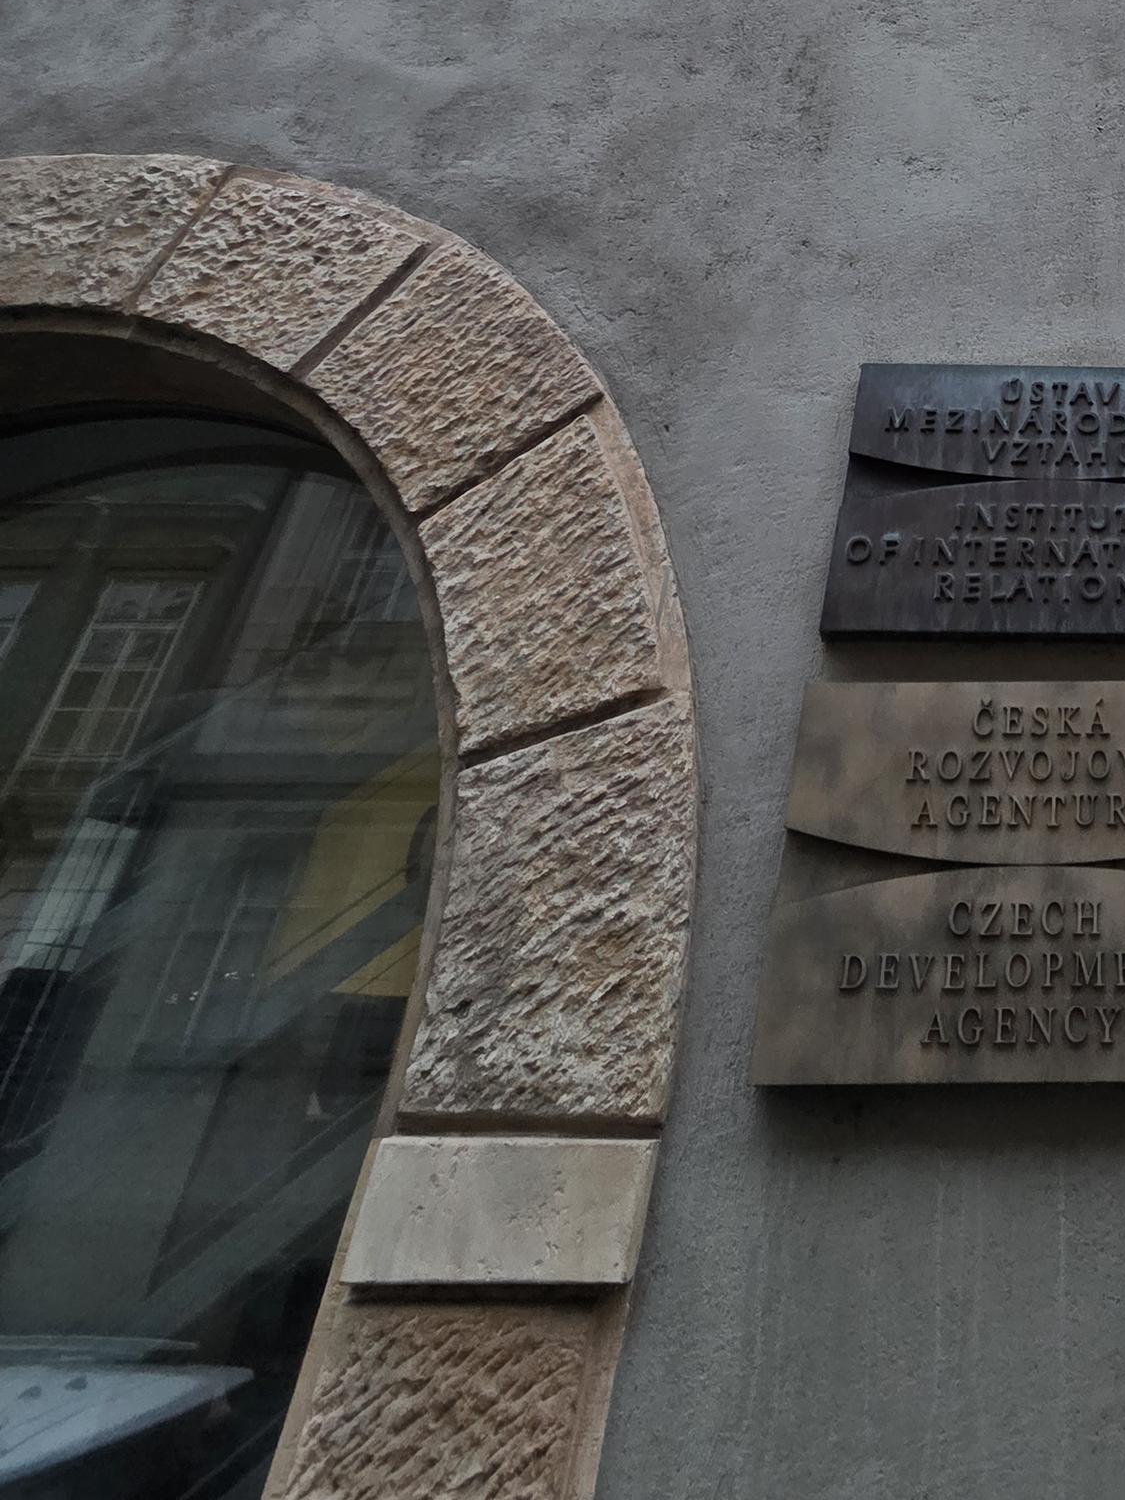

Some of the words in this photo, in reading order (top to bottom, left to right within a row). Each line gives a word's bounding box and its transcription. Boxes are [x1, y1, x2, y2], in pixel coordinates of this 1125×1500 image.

[845, 533, 900, 566] OF
[971, 697, 1111, 739] ČESKÁ
[947, 900, 1102, 937] CZECH
[919, 1004, 1125, 1046] AGENCY
